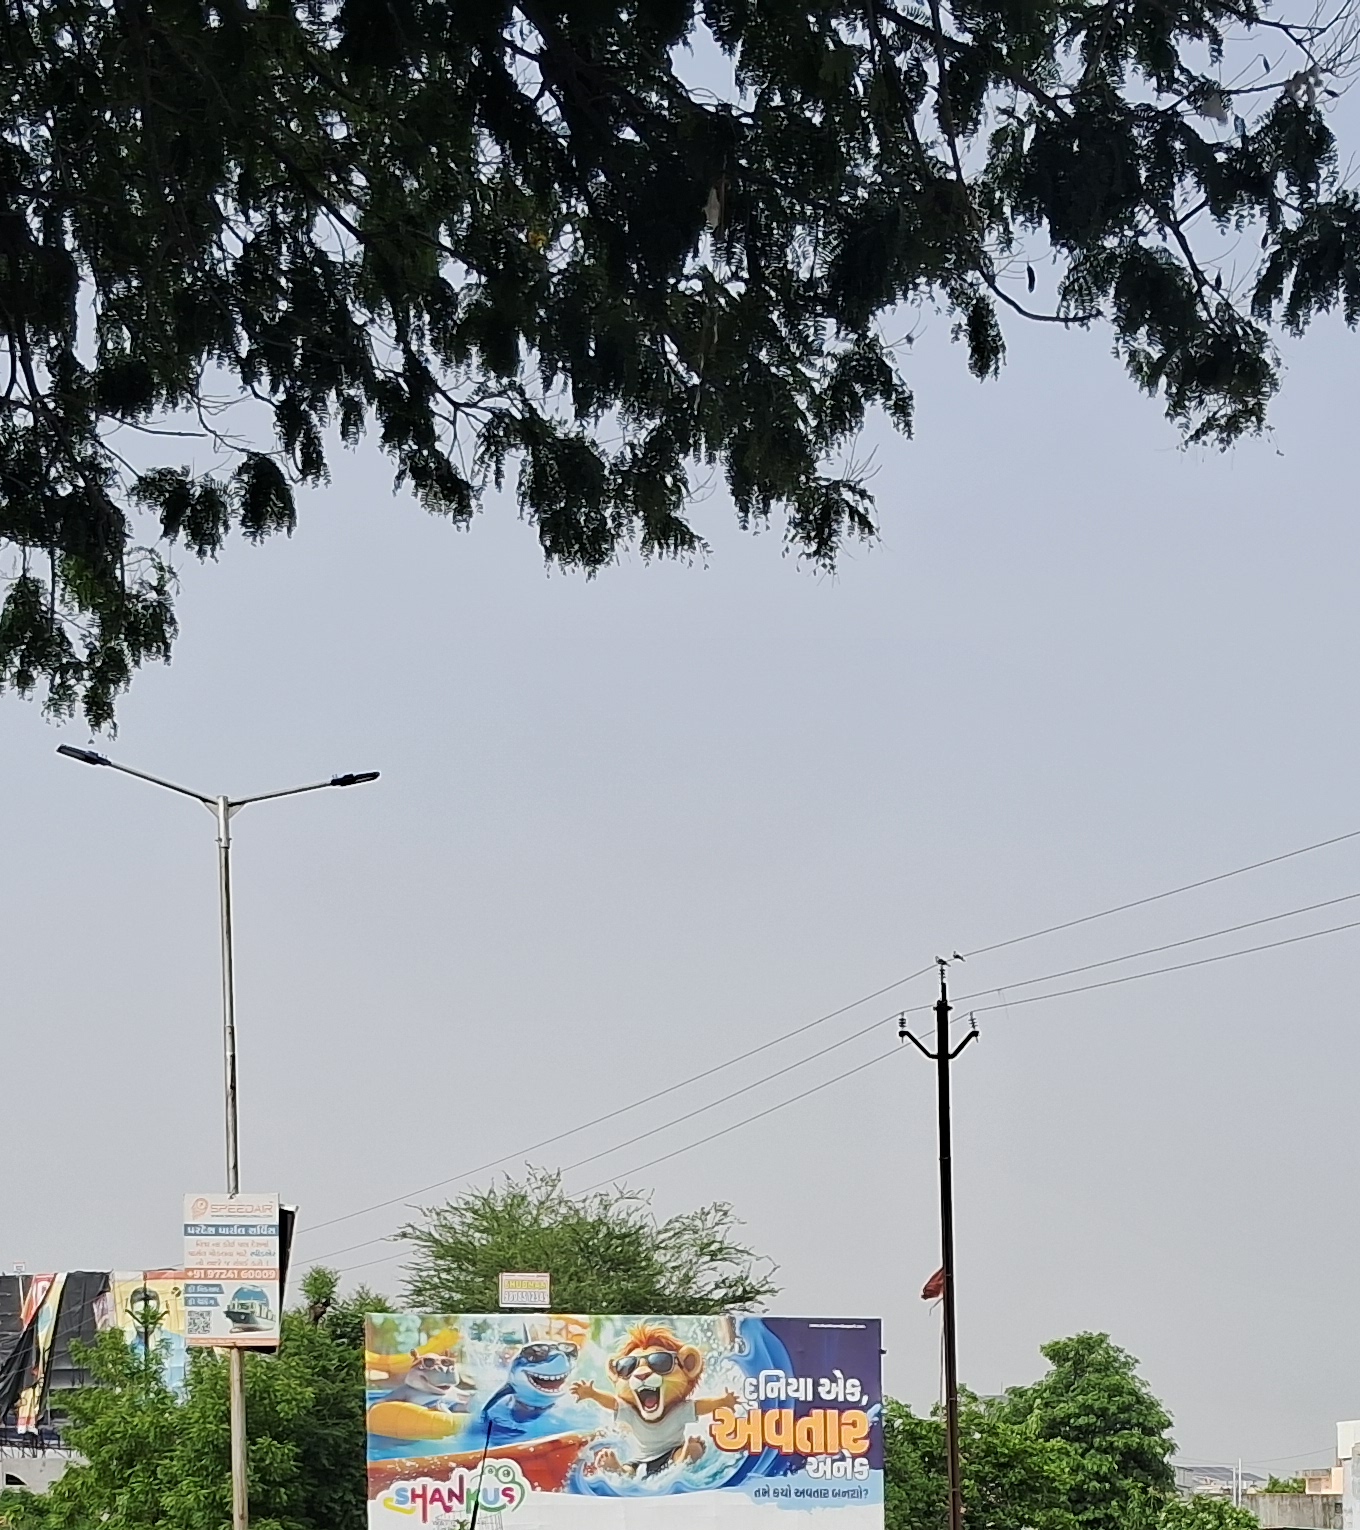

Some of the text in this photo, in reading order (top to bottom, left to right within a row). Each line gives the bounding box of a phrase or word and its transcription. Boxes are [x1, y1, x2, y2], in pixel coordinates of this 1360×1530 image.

[211, 1204, 273, 1214] SPEEDAIR
[186, 1269, 277, 1279] +91 97241 60009
[743, 1368, 869, 1410] દુનિયા એક,
[711, 1407, 870, 1455] અવતાર
[805, 1450, 870, 1480] અનેક
[394, 1473, 516, 1524] SHANKUS
[793, 1487, 829, 1499] અવતાર
